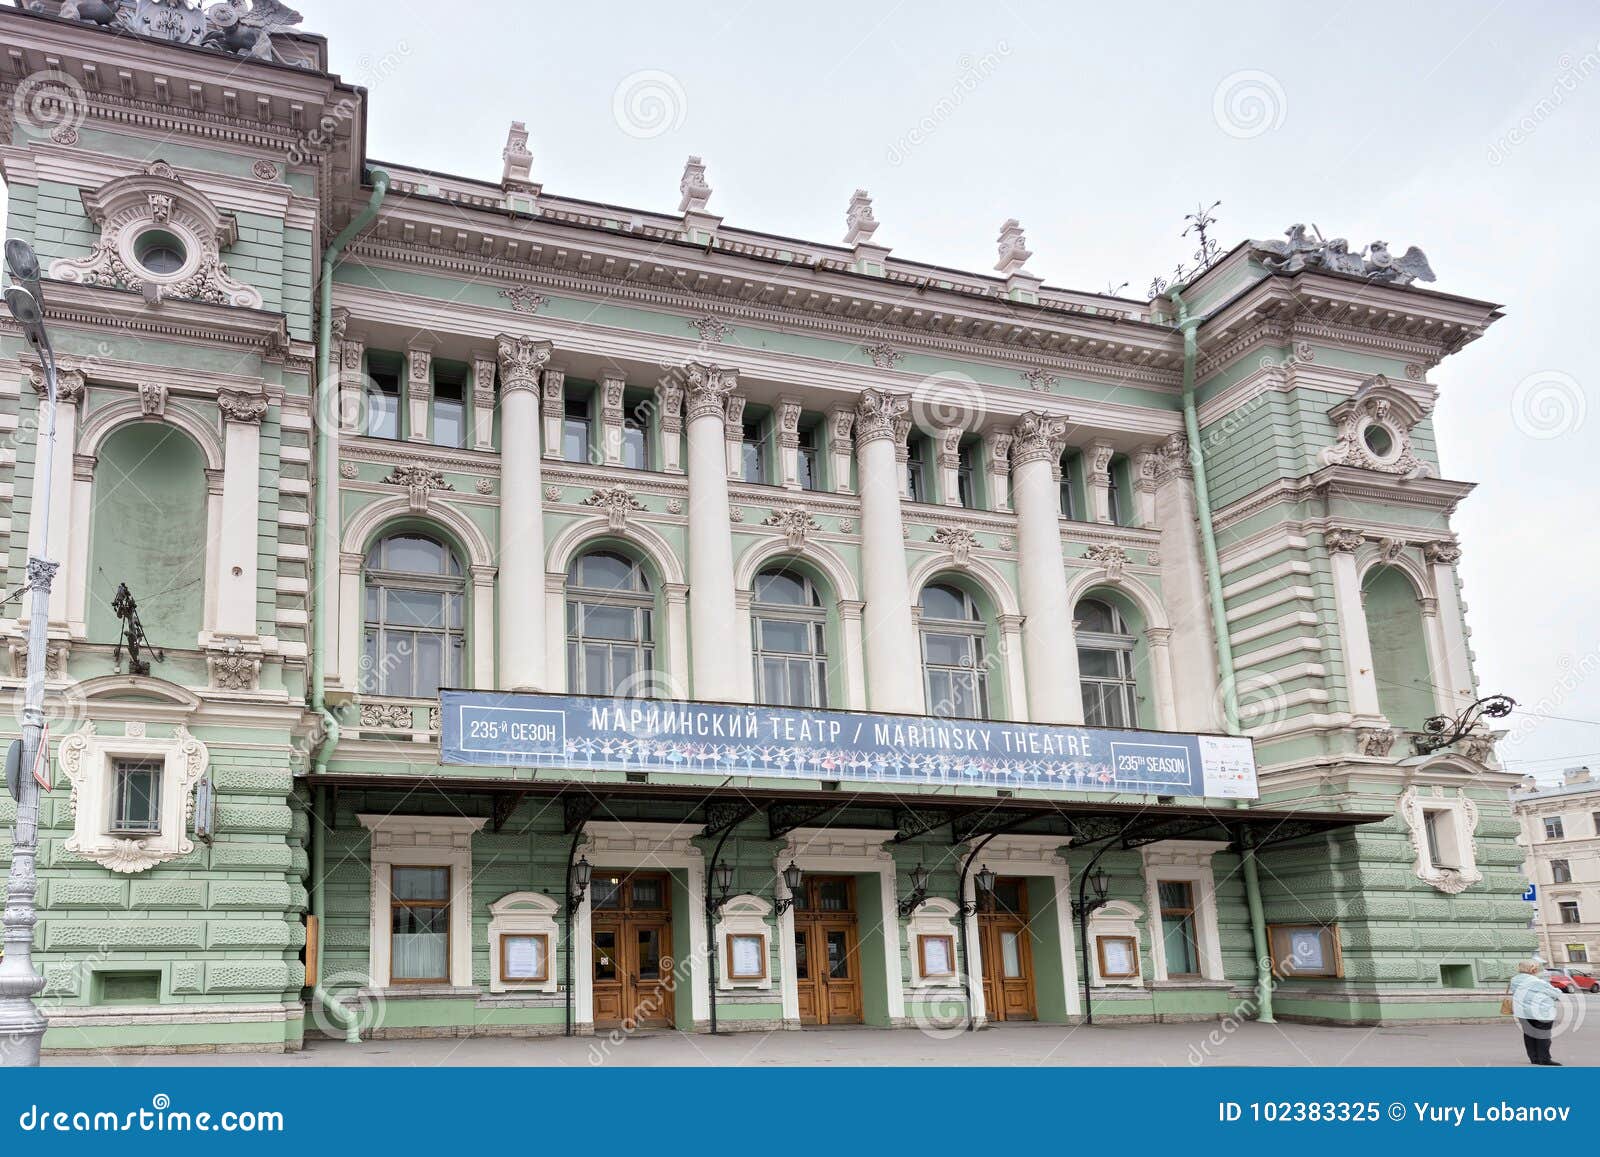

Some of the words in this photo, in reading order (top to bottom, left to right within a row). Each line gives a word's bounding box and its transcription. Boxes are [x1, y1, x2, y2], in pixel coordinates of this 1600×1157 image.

[511, 722, 556, 742] СЕЗОН
[591, 707, 758, 739] МАРИИНСКИЙ
[770, 717, 841, 743] ТЕАТР
[853, 722, 862, 744] /
[874, 723, 991, 751] MARIINSKY
[1002, 731, 1093, 757] THEATRE
[1146, 756, 1185, 773] SEASON
